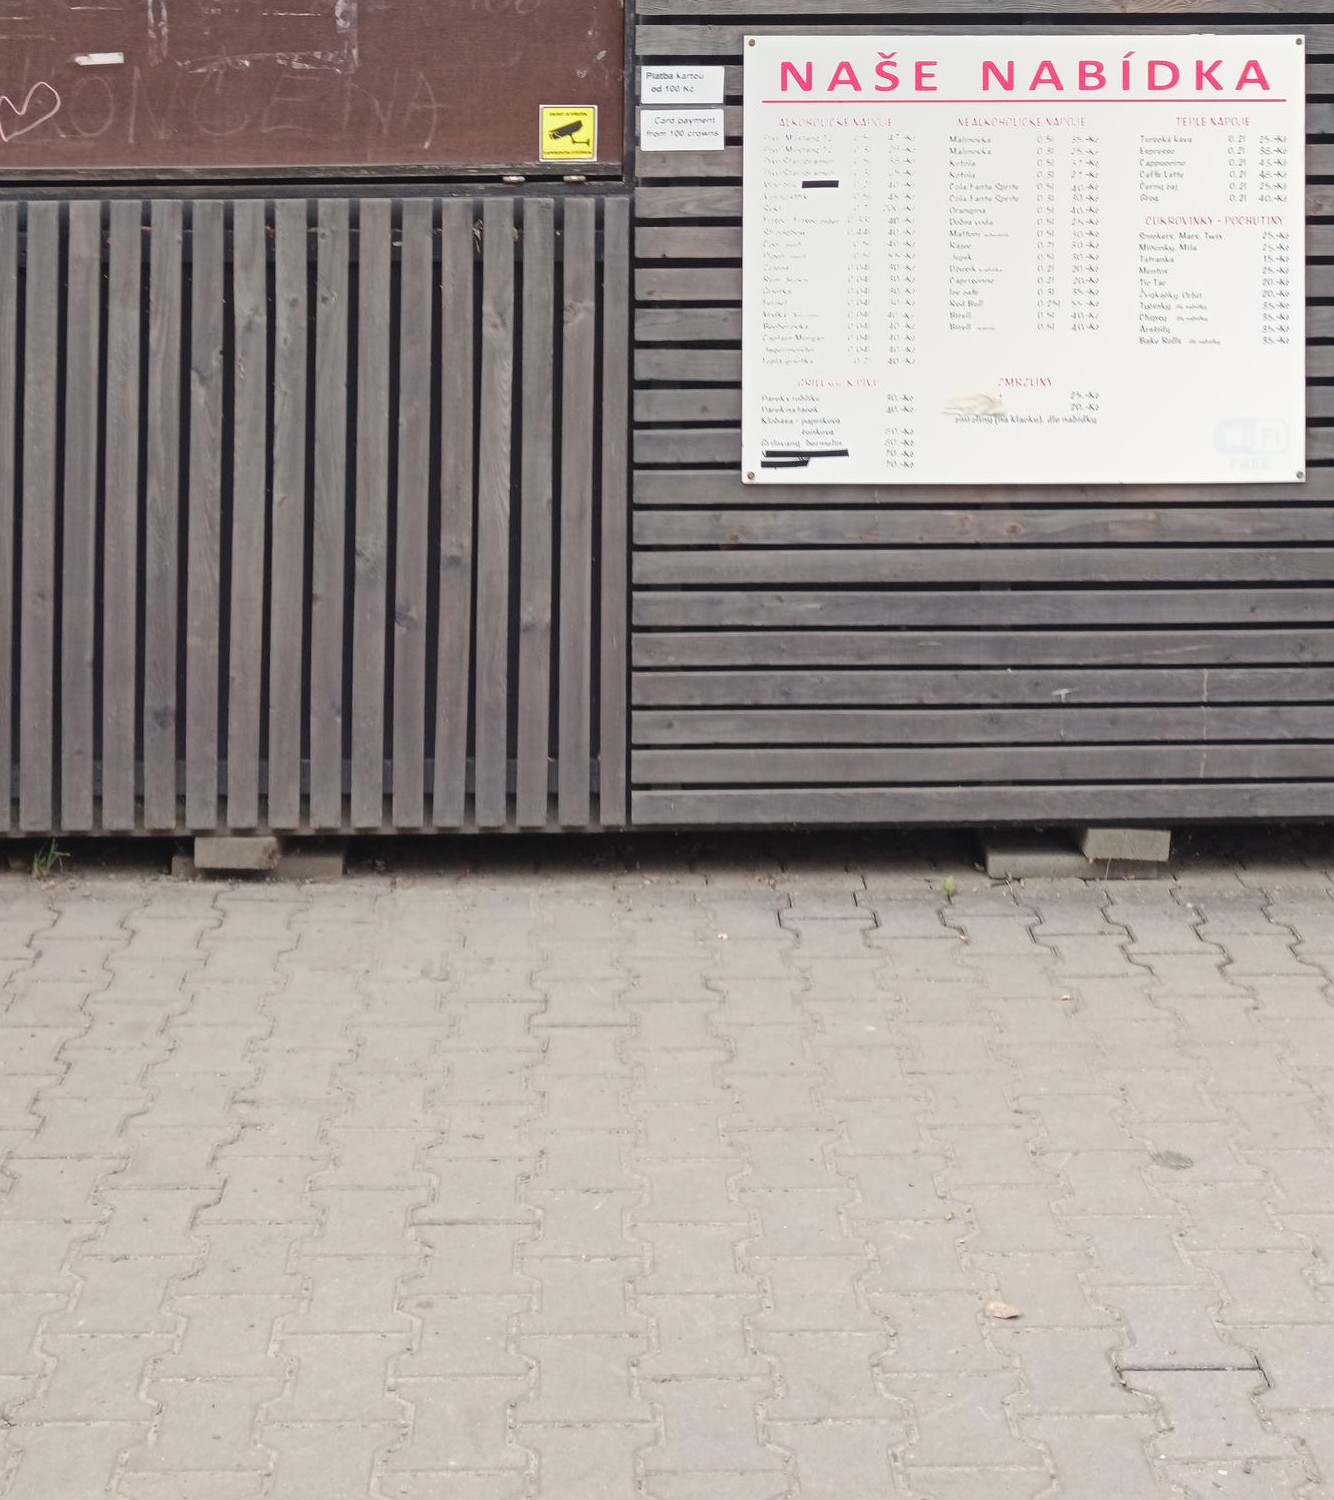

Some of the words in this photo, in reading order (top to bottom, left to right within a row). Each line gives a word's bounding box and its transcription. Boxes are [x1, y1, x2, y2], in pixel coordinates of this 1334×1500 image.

[780, 51, 938, 92] NAŠE
[982, 51, 1271, 91] NABÍDKA
[651, 84, 662, 93] od
[654, 116, 675, 125] Card
[677, 116, 717, 127] payment
[646, 129, 667, 138] from
[687, 130, 720, 138] crowns
